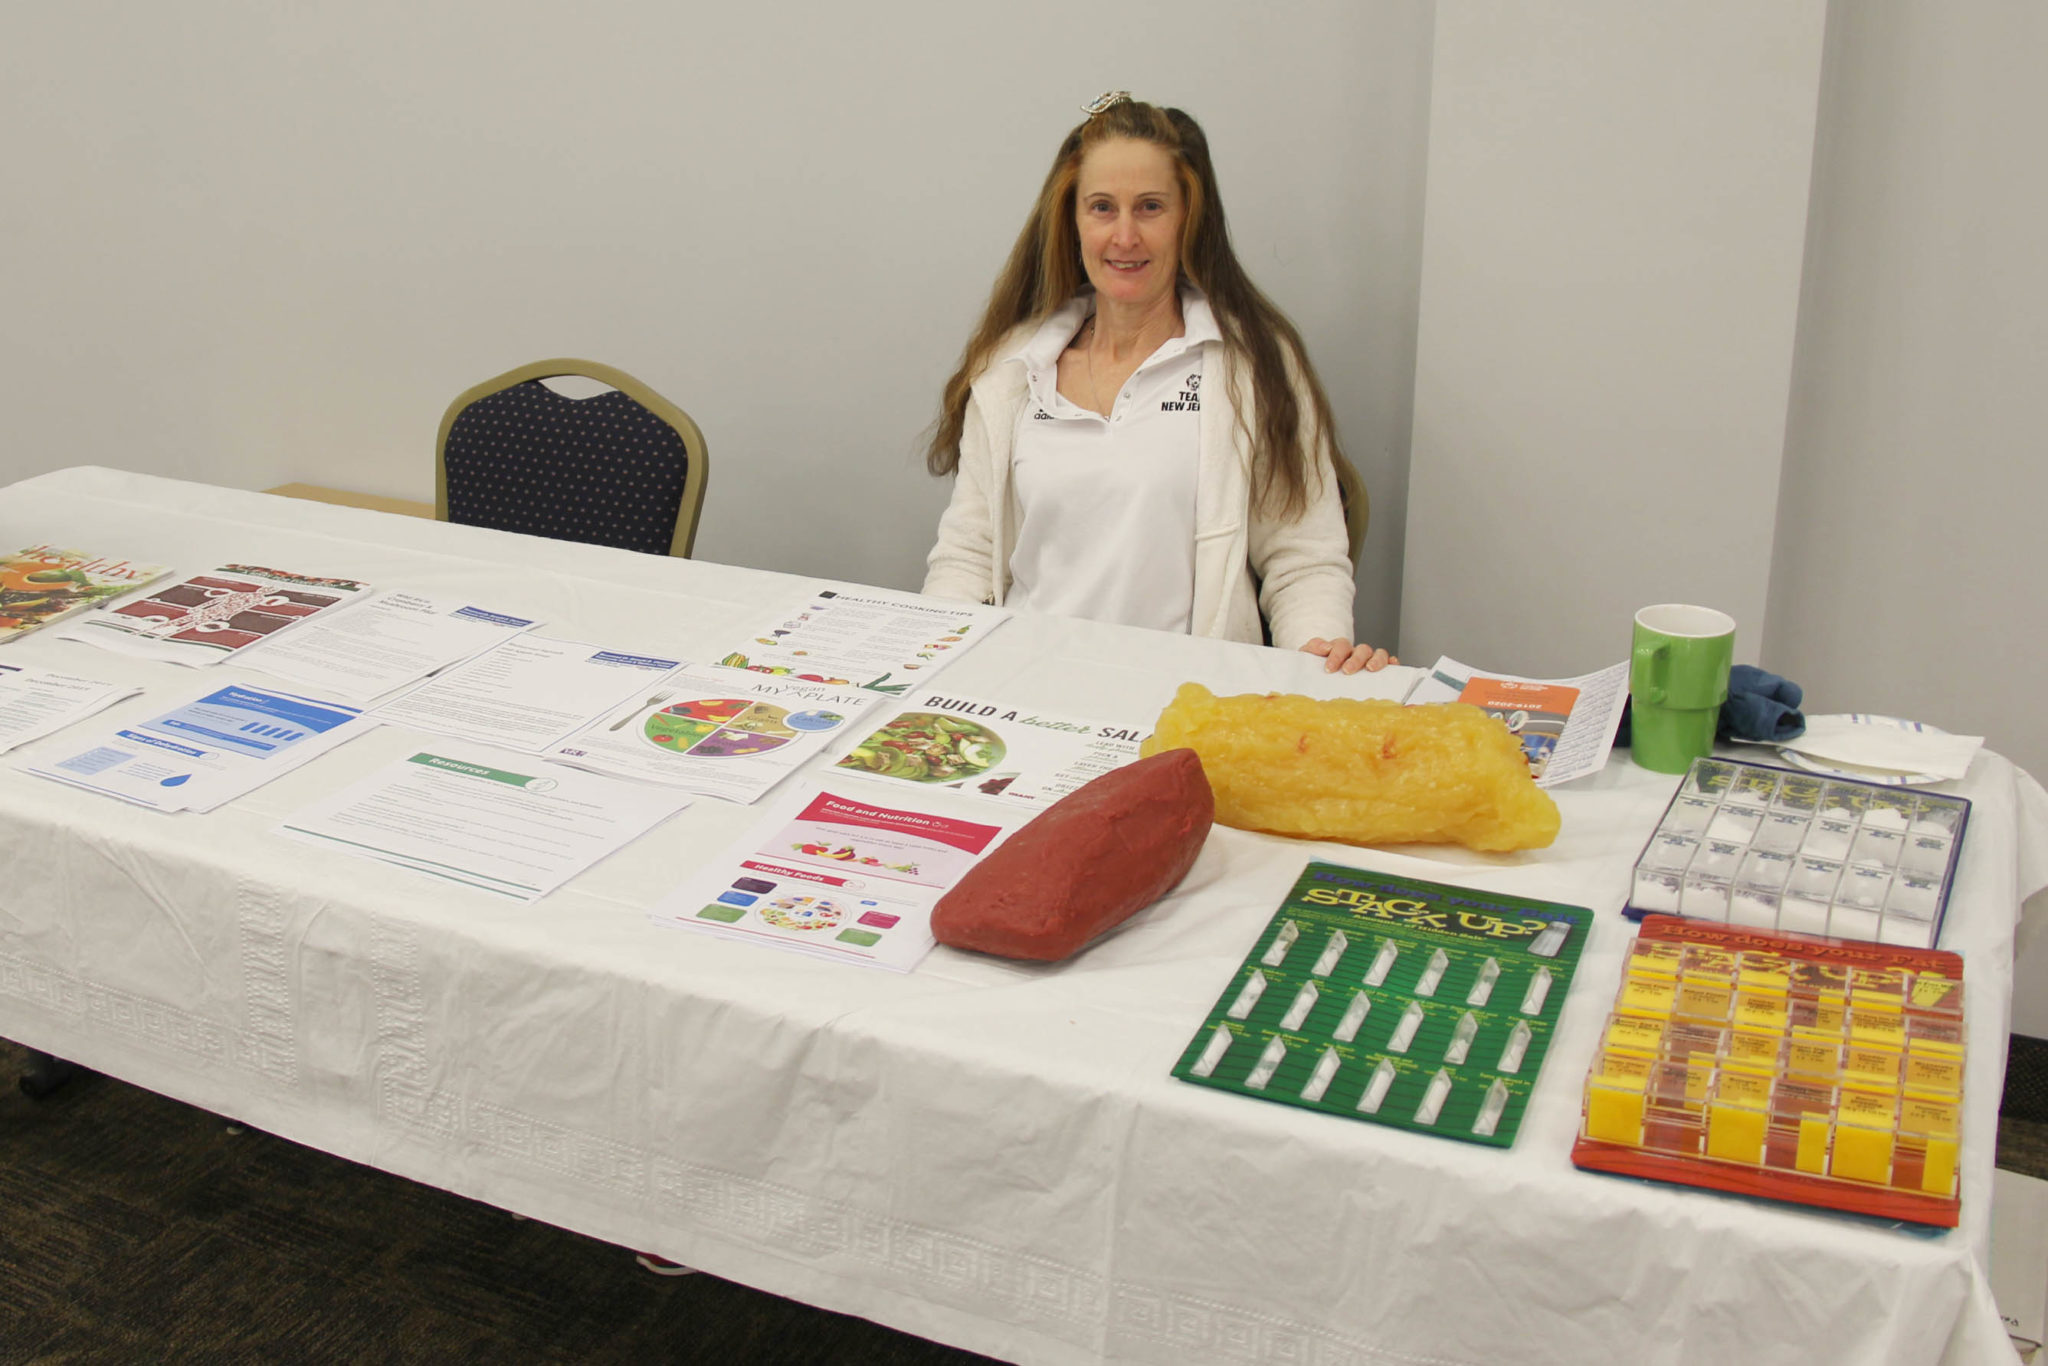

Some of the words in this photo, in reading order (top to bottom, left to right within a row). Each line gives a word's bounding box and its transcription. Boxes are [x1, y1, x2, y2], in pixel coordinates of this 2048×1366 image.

[1161, 402, 1185, 411] NEW
[835, 595, 890, 606] HEALTHY
[891, 602, 947, 615] COOKING
[752, 684, 779, 695] MY
[803, 692, 867, 706] PLATE
[924, 695, 997, 717] BUILD
[1000, 710, 1019, 722] A
[1019, 716, 1091, 734] better
[428, 756, 491, 776] Resources
[826, 800, 855, 811] Food
[856, 808, 877, 817] and
[878, 812, 931, 825] Nutrition
[754, 864, 794, 876] Healthy
[794, 872, 825, 881] Foods
[1312, 871, 1377, 891] How
[1379, 883, 1442, 901] does
[1448, 894, 1512, 916] your
[1516, 906, 1581, 924] Salt
[1301, 888, 1447, 928] STACK
[1456, 910, 1548, 938] UP?
[1418, 925, 1458, 937] Hidden
[1660, 924, 1731, 941] How
[1732, 932, 1803, 950] does
[1810, 944, 1882, 961] your
[1889, 953, 1946, 969] Fat
